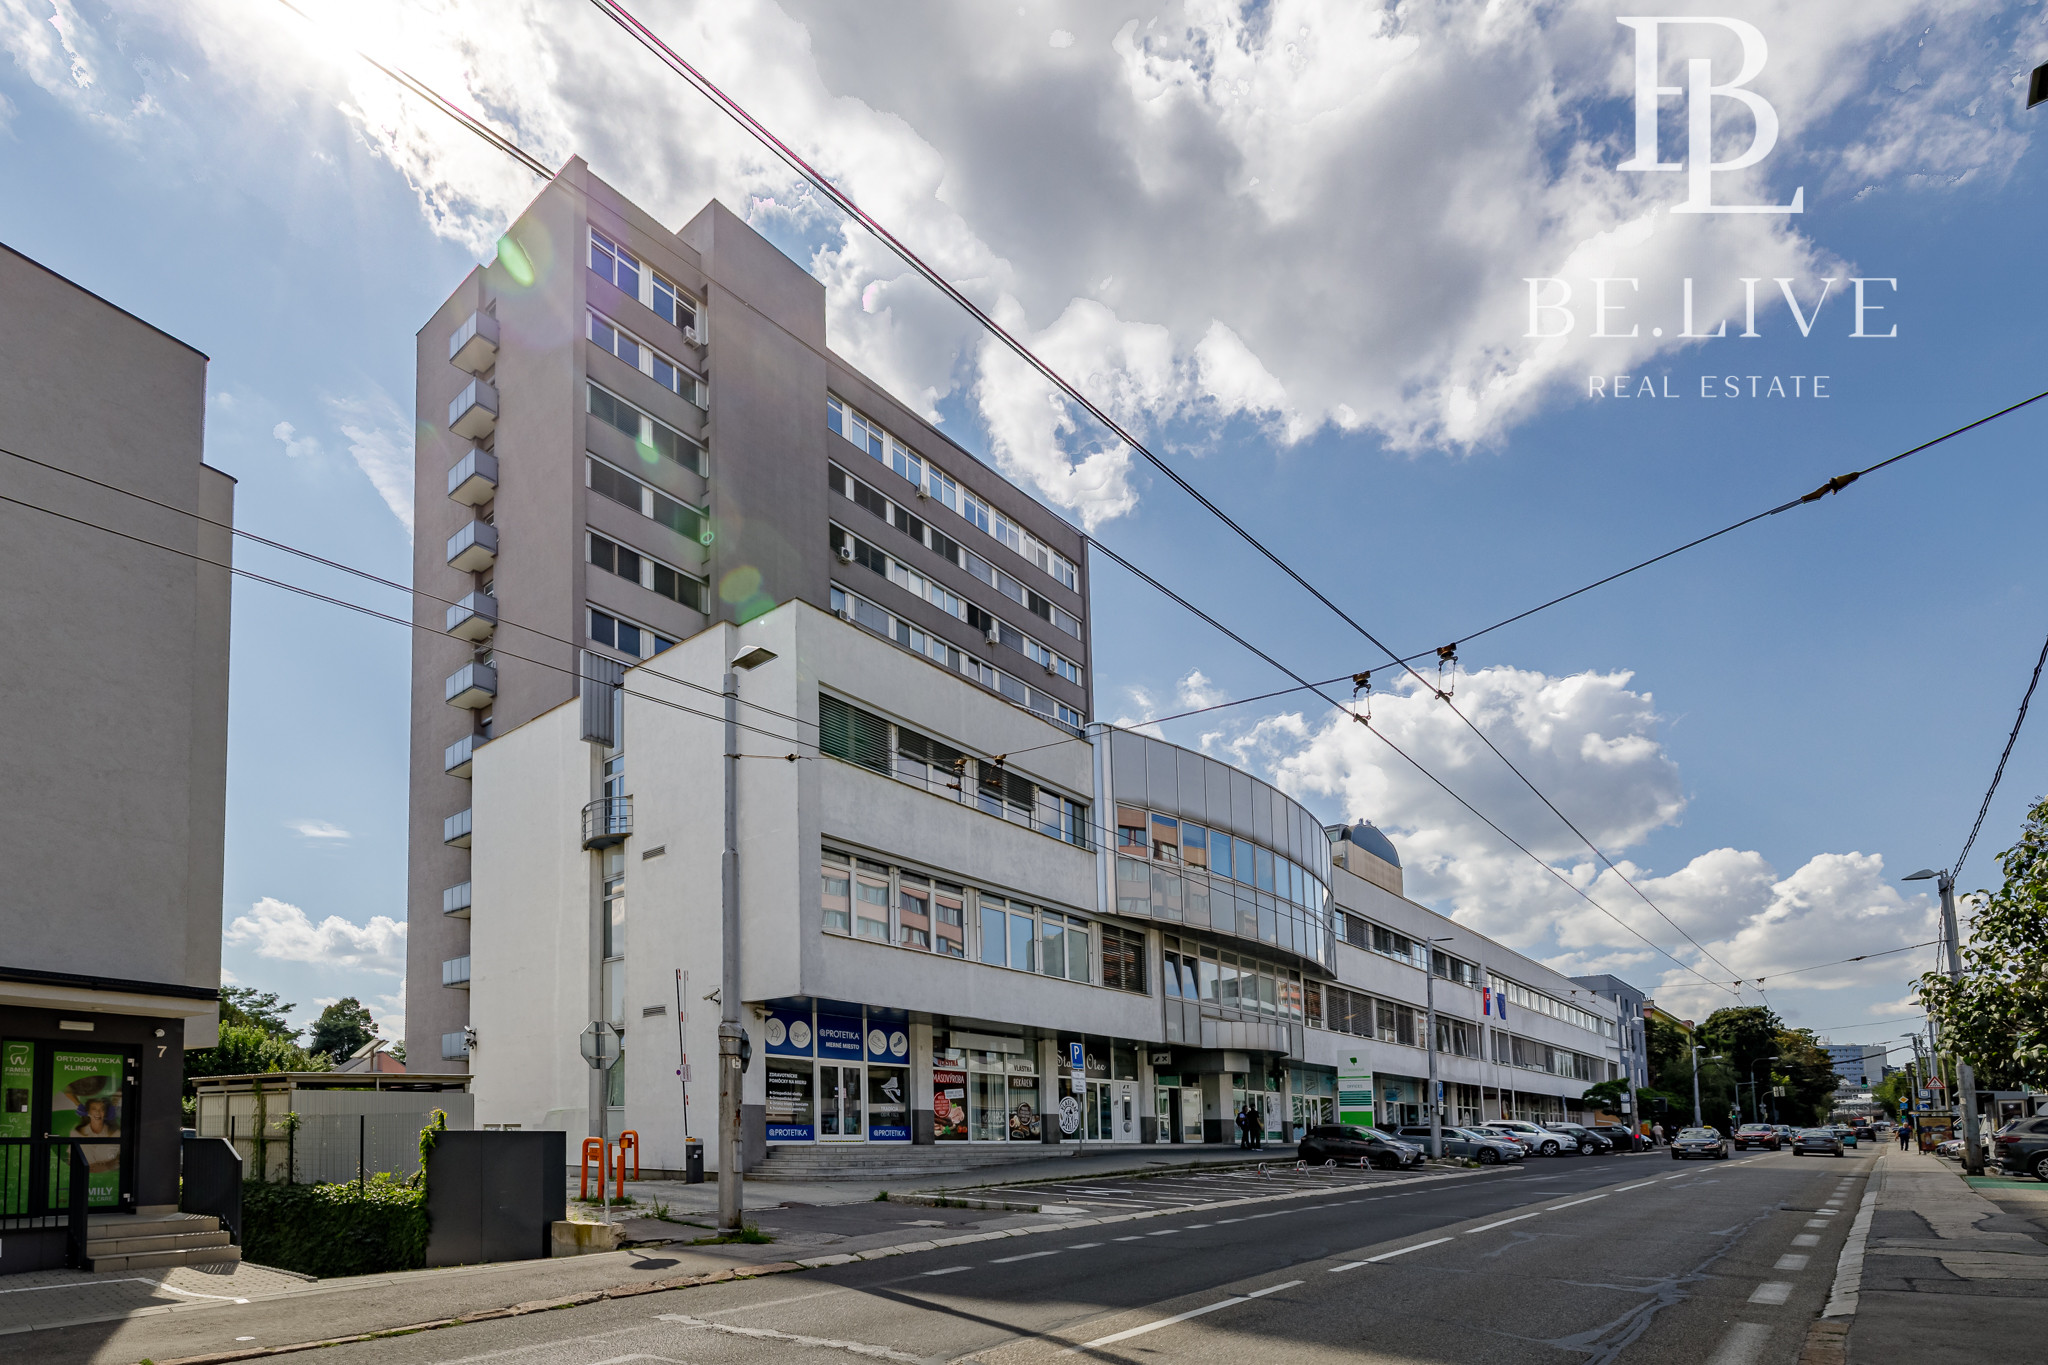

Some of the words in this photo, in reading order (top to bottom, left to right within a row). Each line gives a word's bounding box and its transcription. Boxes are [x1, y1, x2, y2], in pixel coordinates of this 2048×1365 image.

[157, 1045, 167, 1058] 7
[1073, 1045, 1080, 1060] P
[56, 1055, 121, 1064] ORTODONTICKÁ
[64, 1064, 98, 1072] KLINIKA
